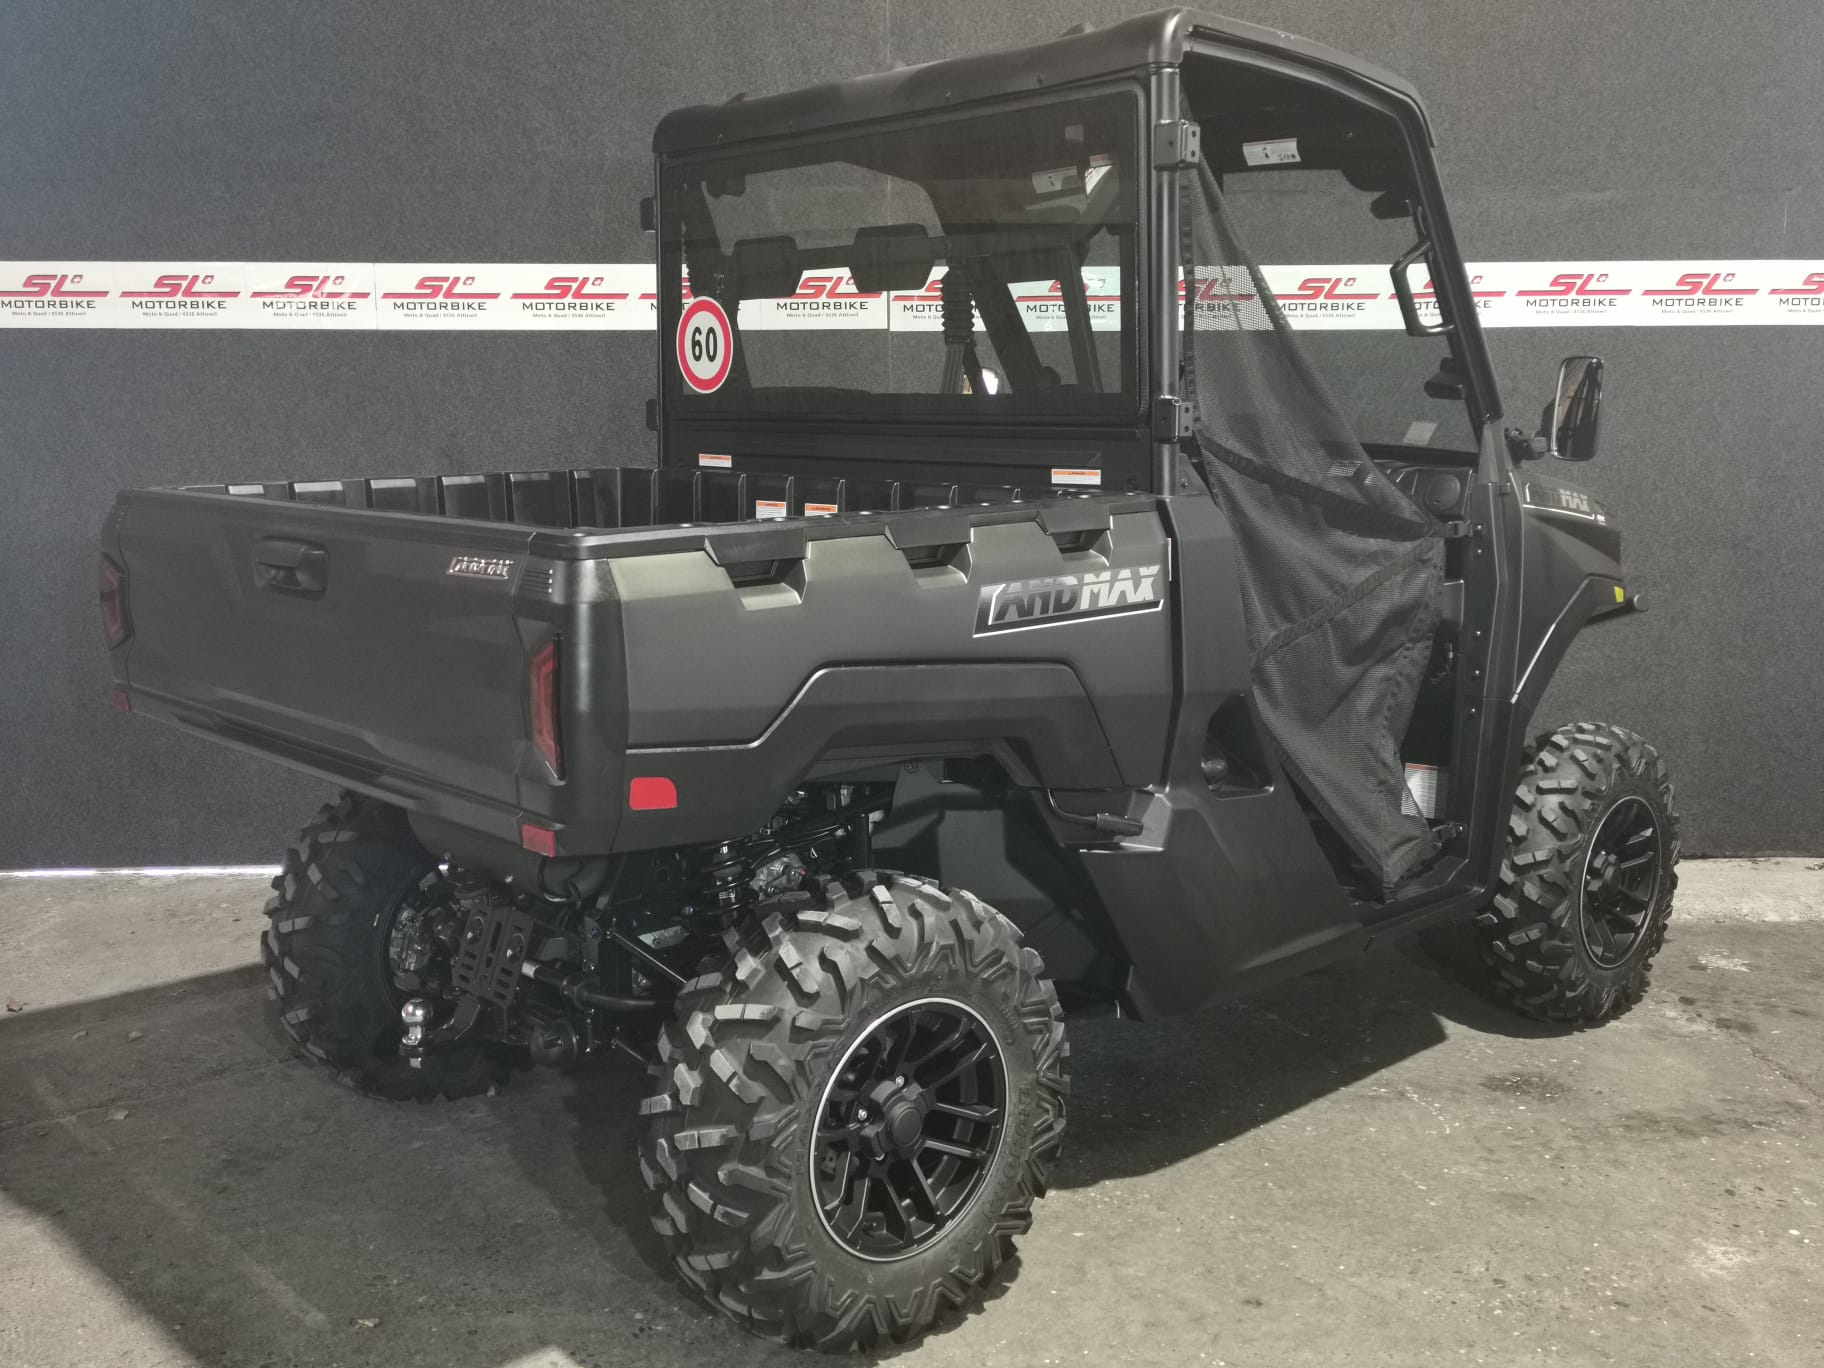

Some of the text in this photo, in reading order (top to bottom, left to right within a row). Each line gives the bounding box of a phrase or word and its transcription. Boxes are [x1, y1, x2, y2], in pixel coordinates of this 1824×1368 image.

[1, 299, 97, 309] MOTORBIKE
[131, 300, 228, 309] MOTORBIKE
[262, 301, 357, 310] MOTORBIKE
[393, 301, 487, 311] MOTORBIKE
[522, 302, 616, 311] MOTORBIKE
[776, 301, 869, 311] MOTORBIKE
[1281, 302, 1366, 311] MOTORBIKE
[1526, 298, 1617, 308] MOTORBIKE
[1652, 297, 1744, 307] MOTORBIKE
[1026, 304, 1115, 313] MOTOBIKE
[692, 326, 718, 362] 60
